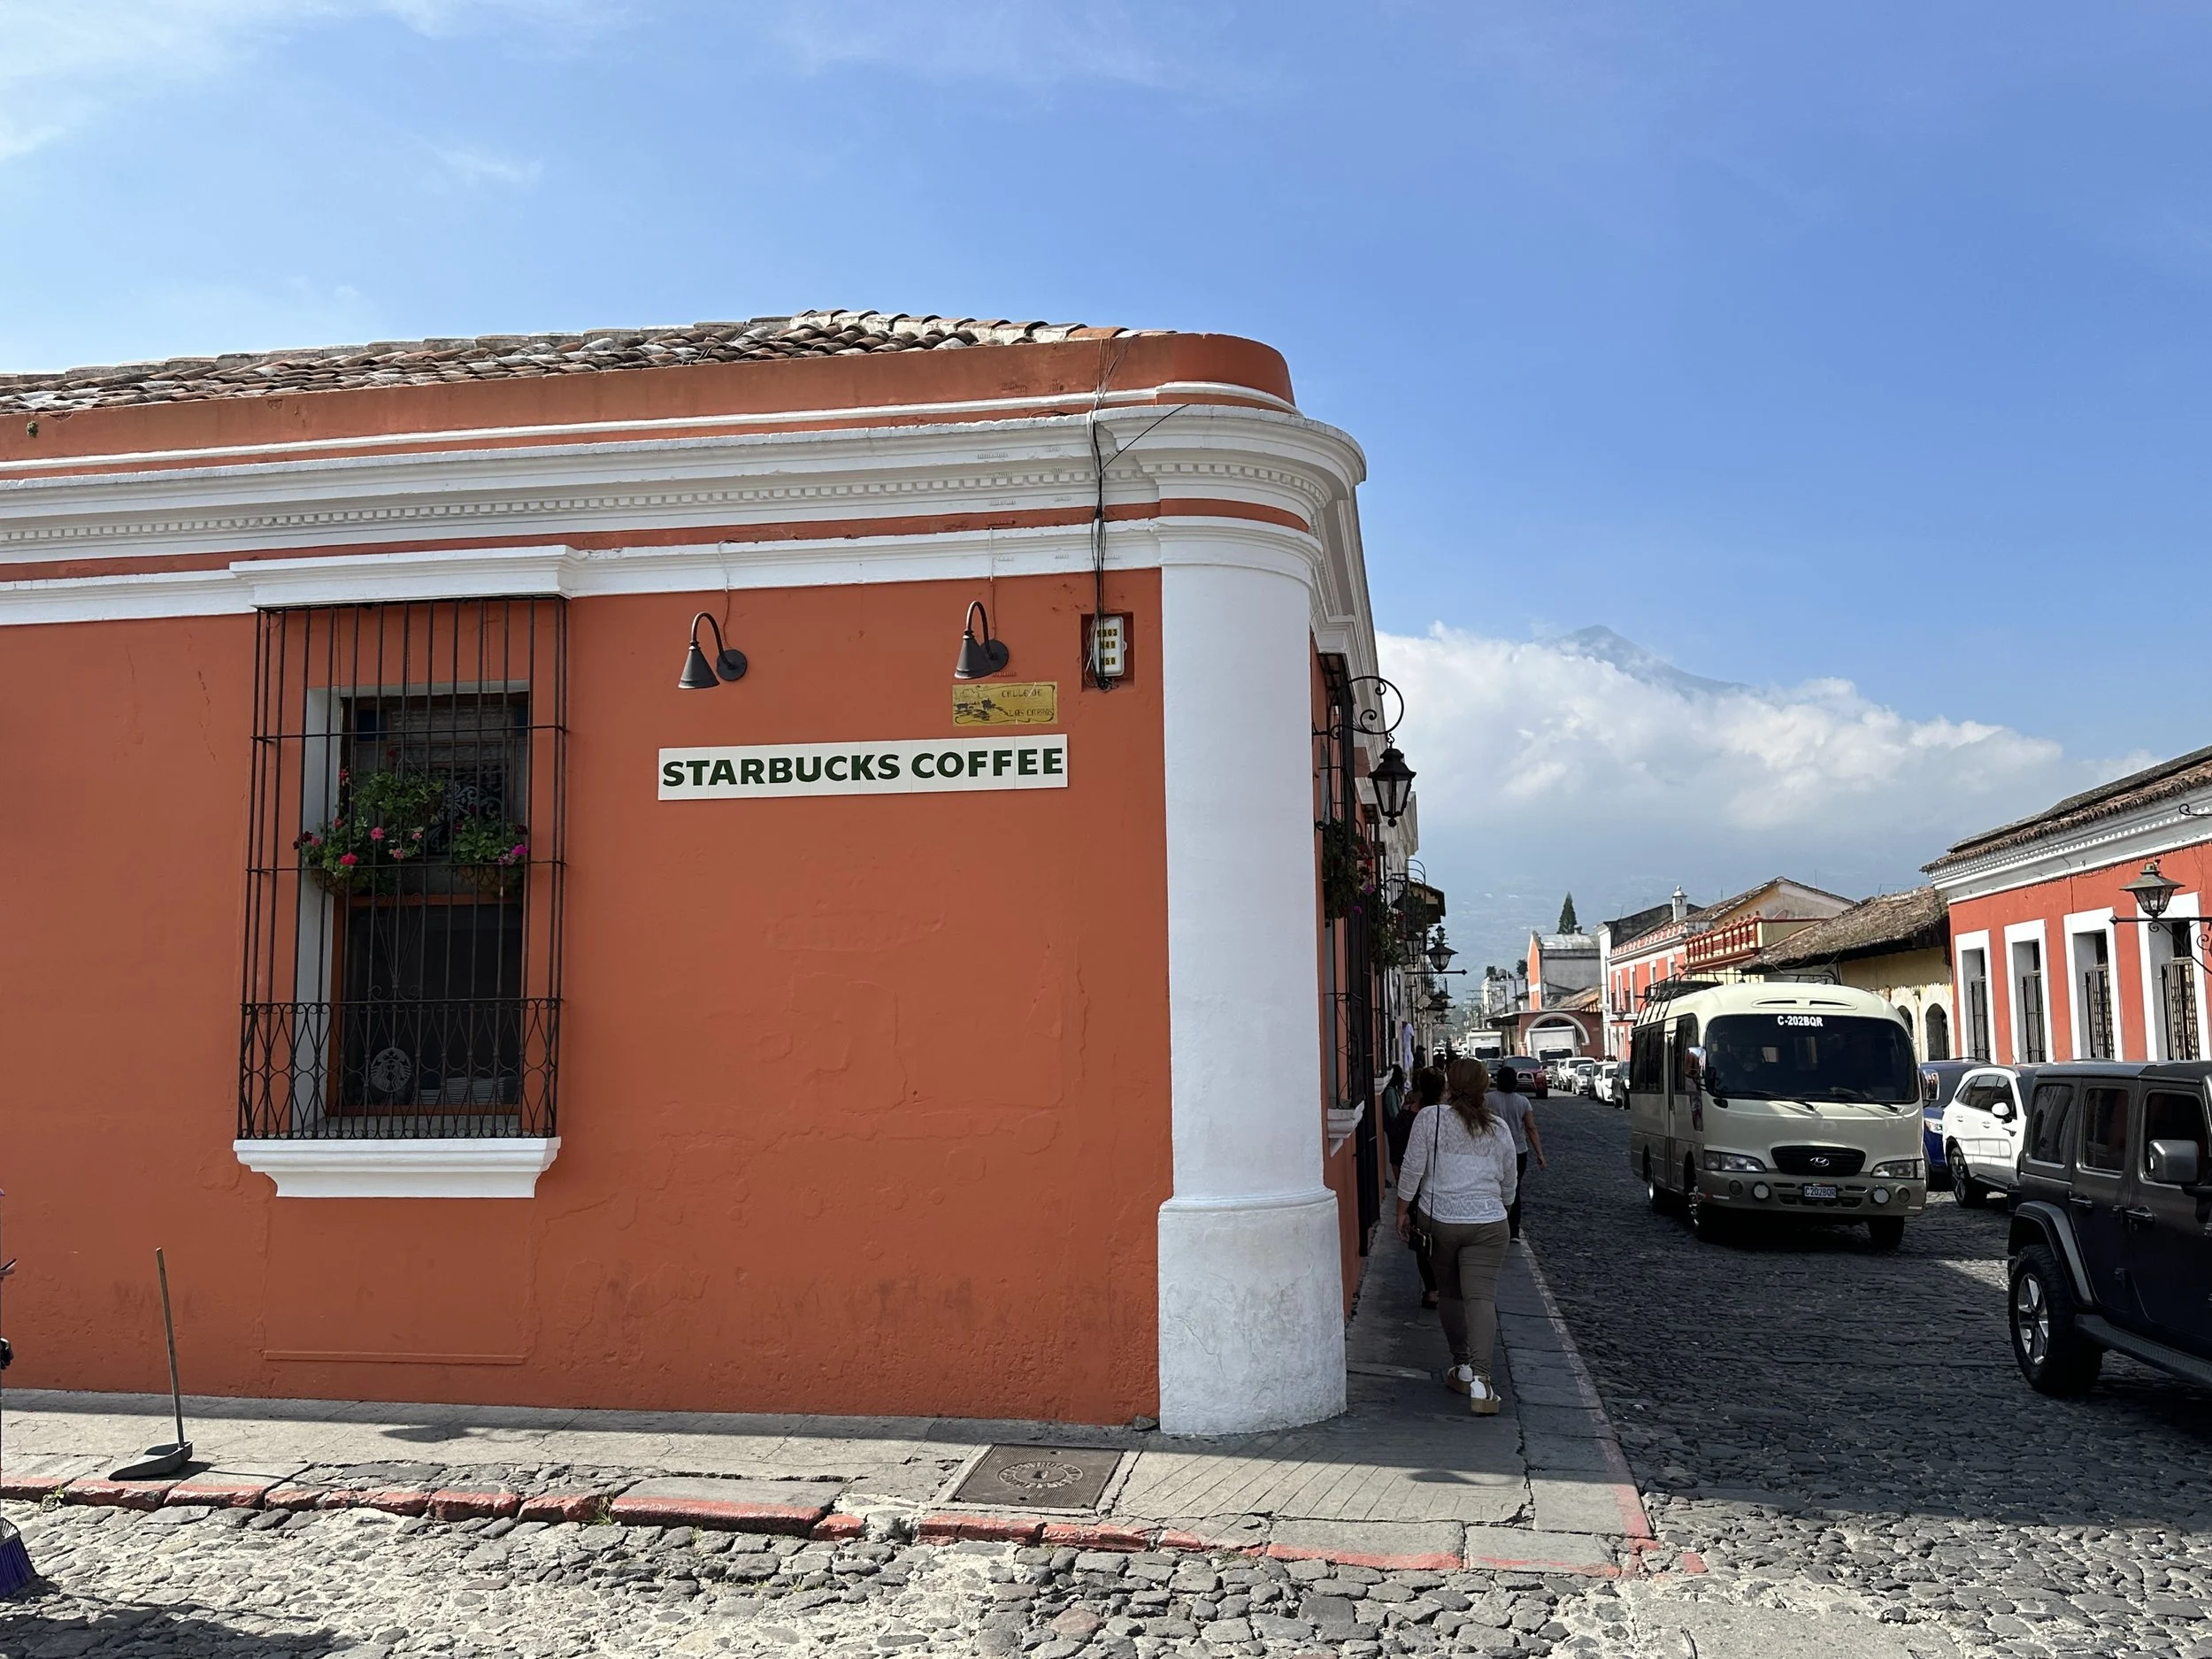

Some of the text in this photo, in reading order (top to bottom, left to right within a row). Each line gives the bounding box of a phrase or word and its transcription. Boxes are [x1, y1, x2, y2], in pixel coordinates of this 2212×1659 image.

[662, 748, 1064, 787] STARBUCKS COFFEE
[1777, 1015, 1824, 1027] C-202BQR
